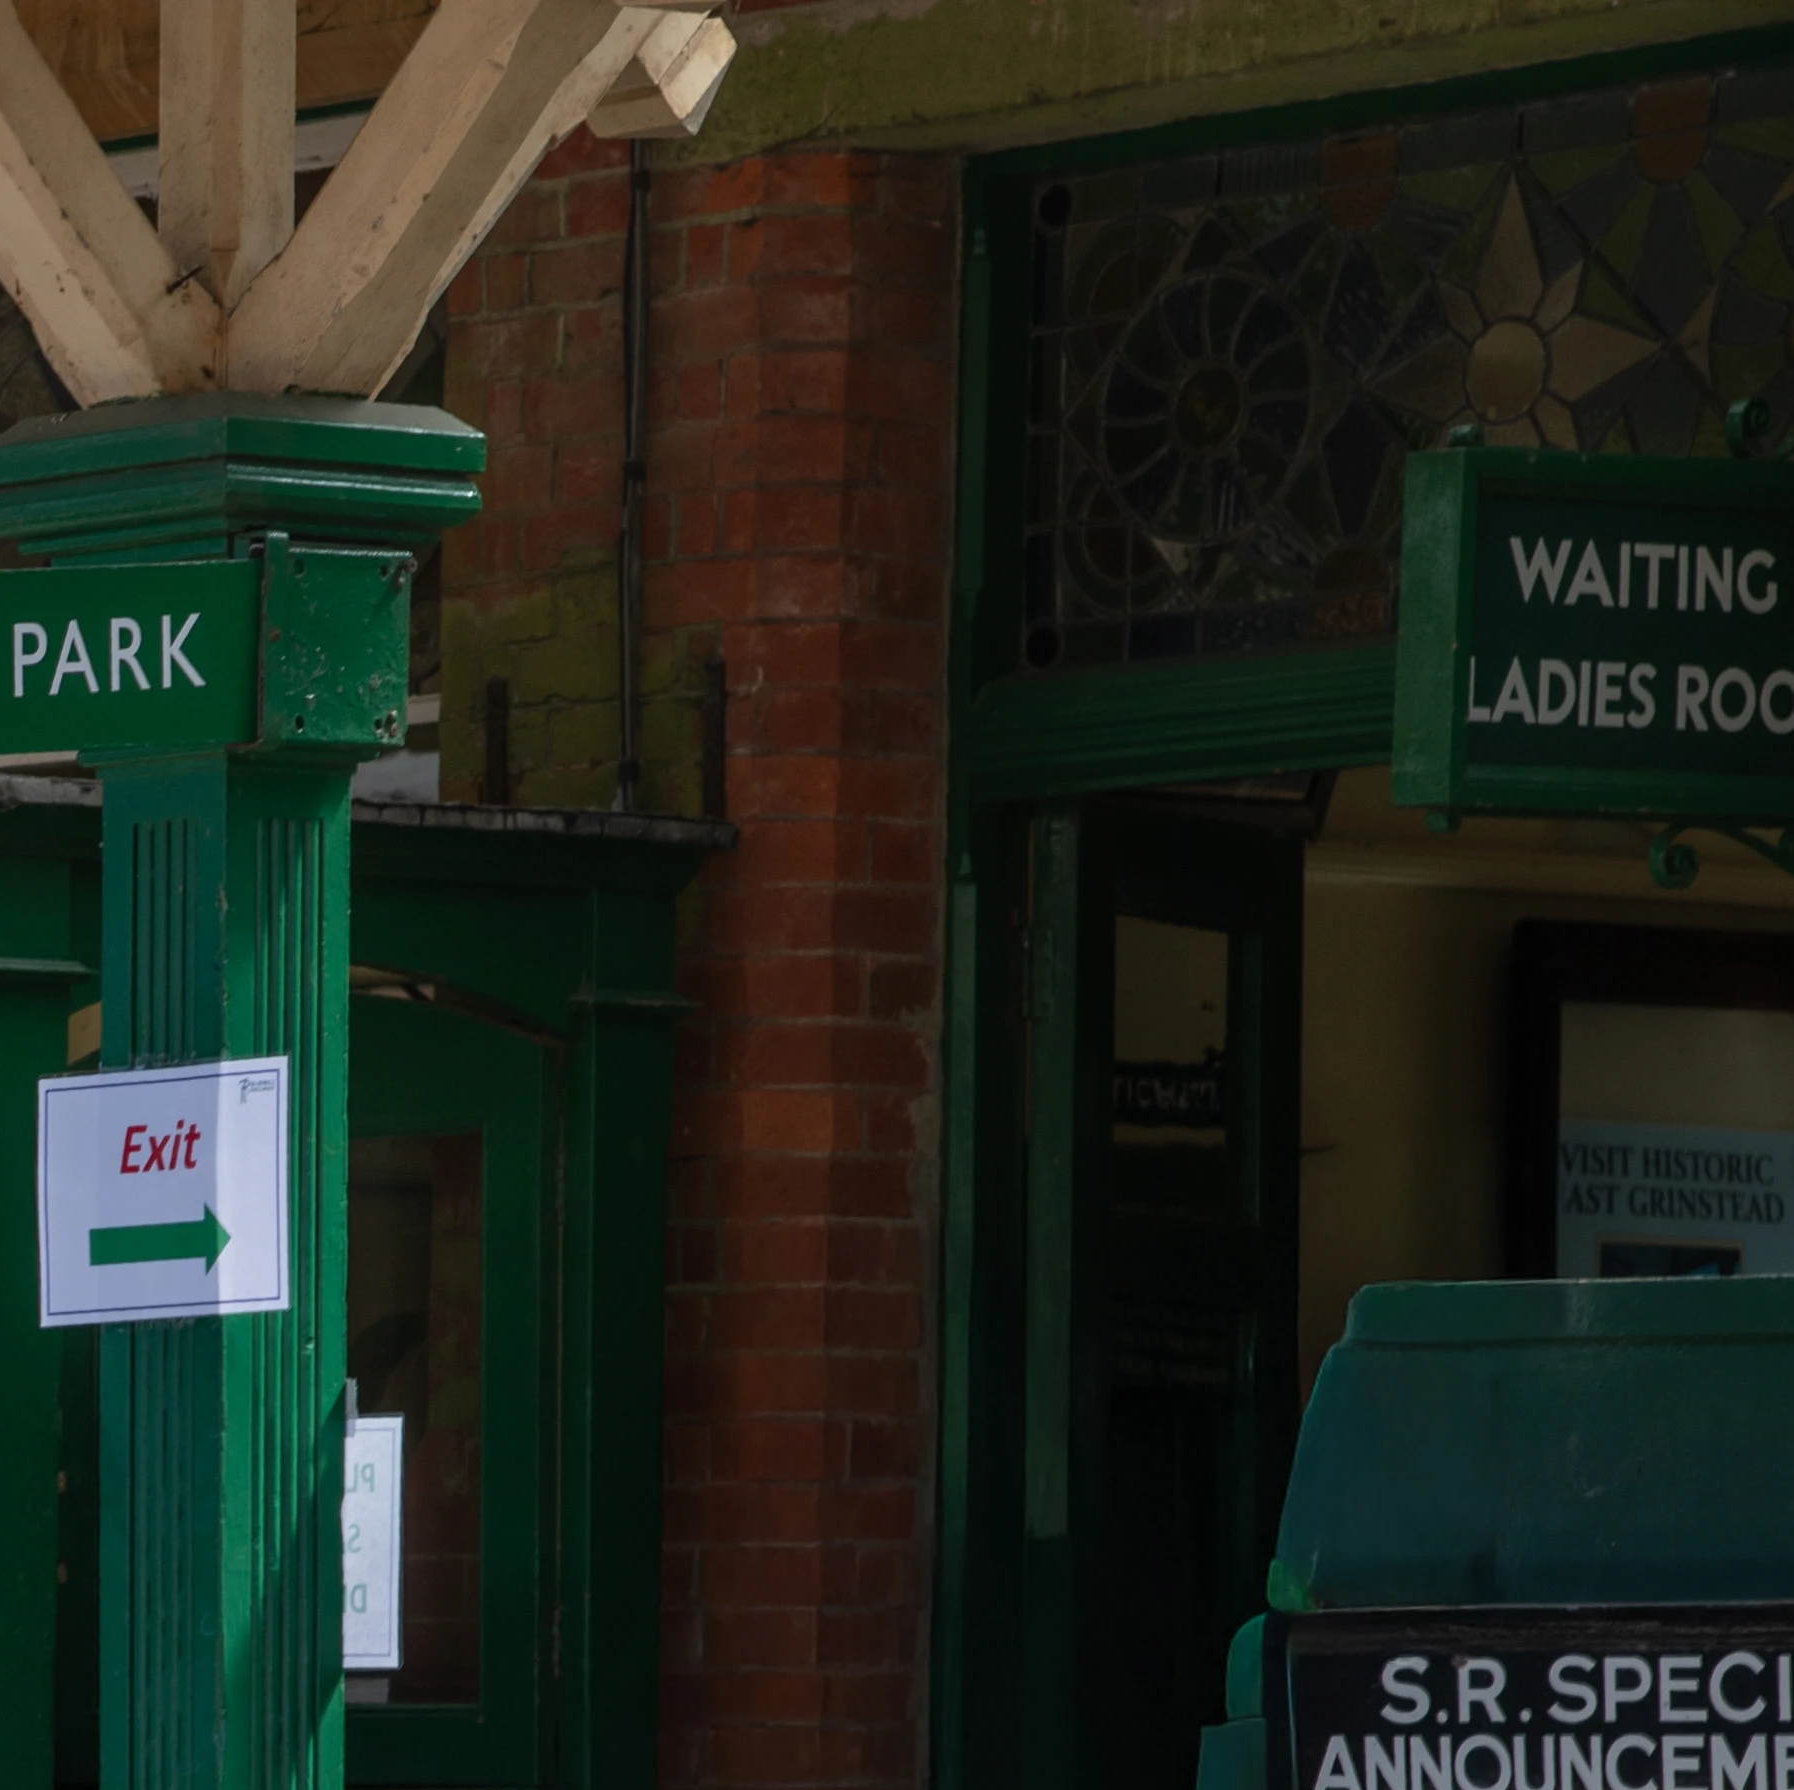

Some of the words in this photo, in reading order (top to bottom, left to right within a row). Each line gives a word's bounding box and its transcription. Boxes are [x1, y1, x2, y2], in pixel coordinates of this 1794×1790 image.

[1509, 535, 1779, 614] WAITING
[13, 611, 207, 698] PARK
[1467, 655, 1657, 731] LADIES
[119, 1119, 201, 1175] Exit
[1561, 1143, 1632, 1176] VISIT
[1642, 1146, 1775, 1185] HISTORIC
[1562, 1182, 1620, 1214] AST
[1628, 1185, 1785, 1223] GRINSTEAD
[1546, 1650, 1791, 1725] SPECI
